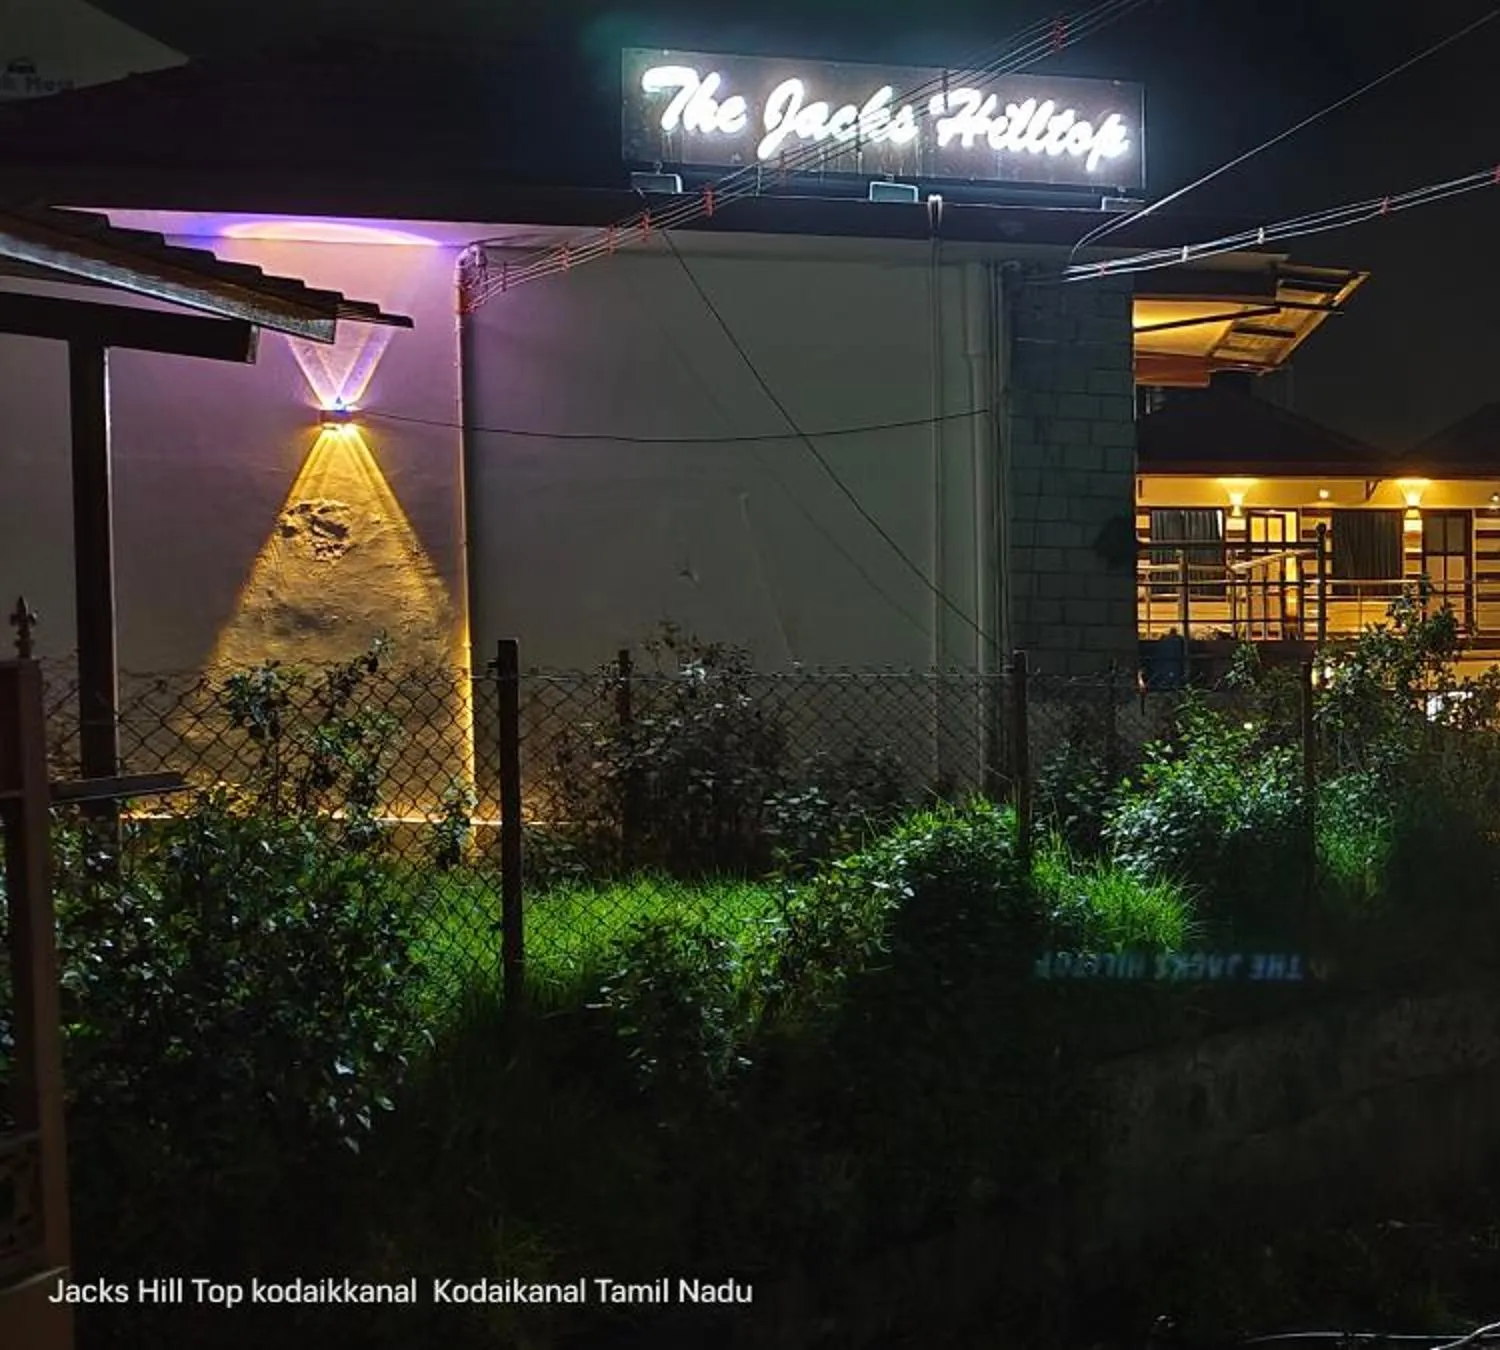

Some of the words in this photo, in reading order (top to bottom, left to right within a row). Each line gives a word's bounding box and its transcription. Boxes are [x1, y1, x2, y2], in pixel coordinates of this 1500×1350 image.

[641, 66, 748, 133] The
[757, 78, 919, 159] Jacks
[929, 88, 1130, 172] Hilltop
